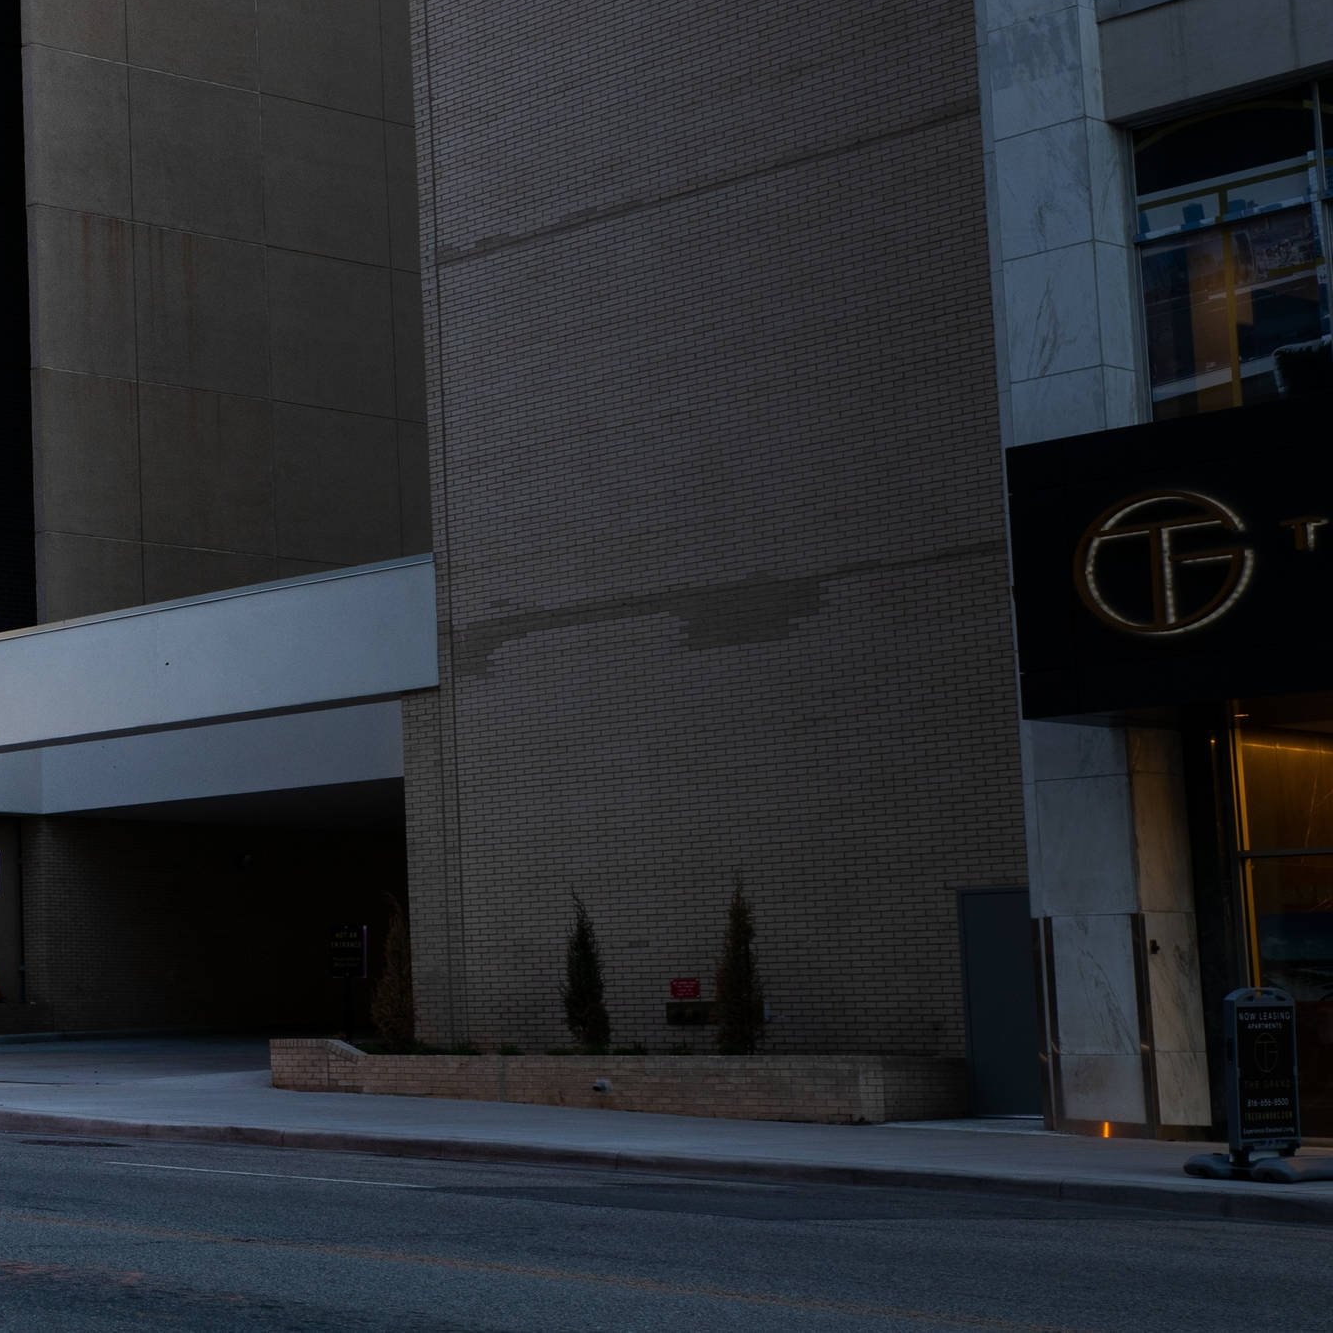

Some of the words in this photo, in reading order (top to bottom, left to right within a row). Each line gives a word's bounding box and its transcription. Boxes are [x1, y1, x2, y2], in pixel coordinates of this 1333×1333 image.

[1238, 1011, 1256, 1020] NOW
[1259, 1010, 1290, 1020] LEASING
[1247, 1022, 1283, 1030] APARTMENTS
